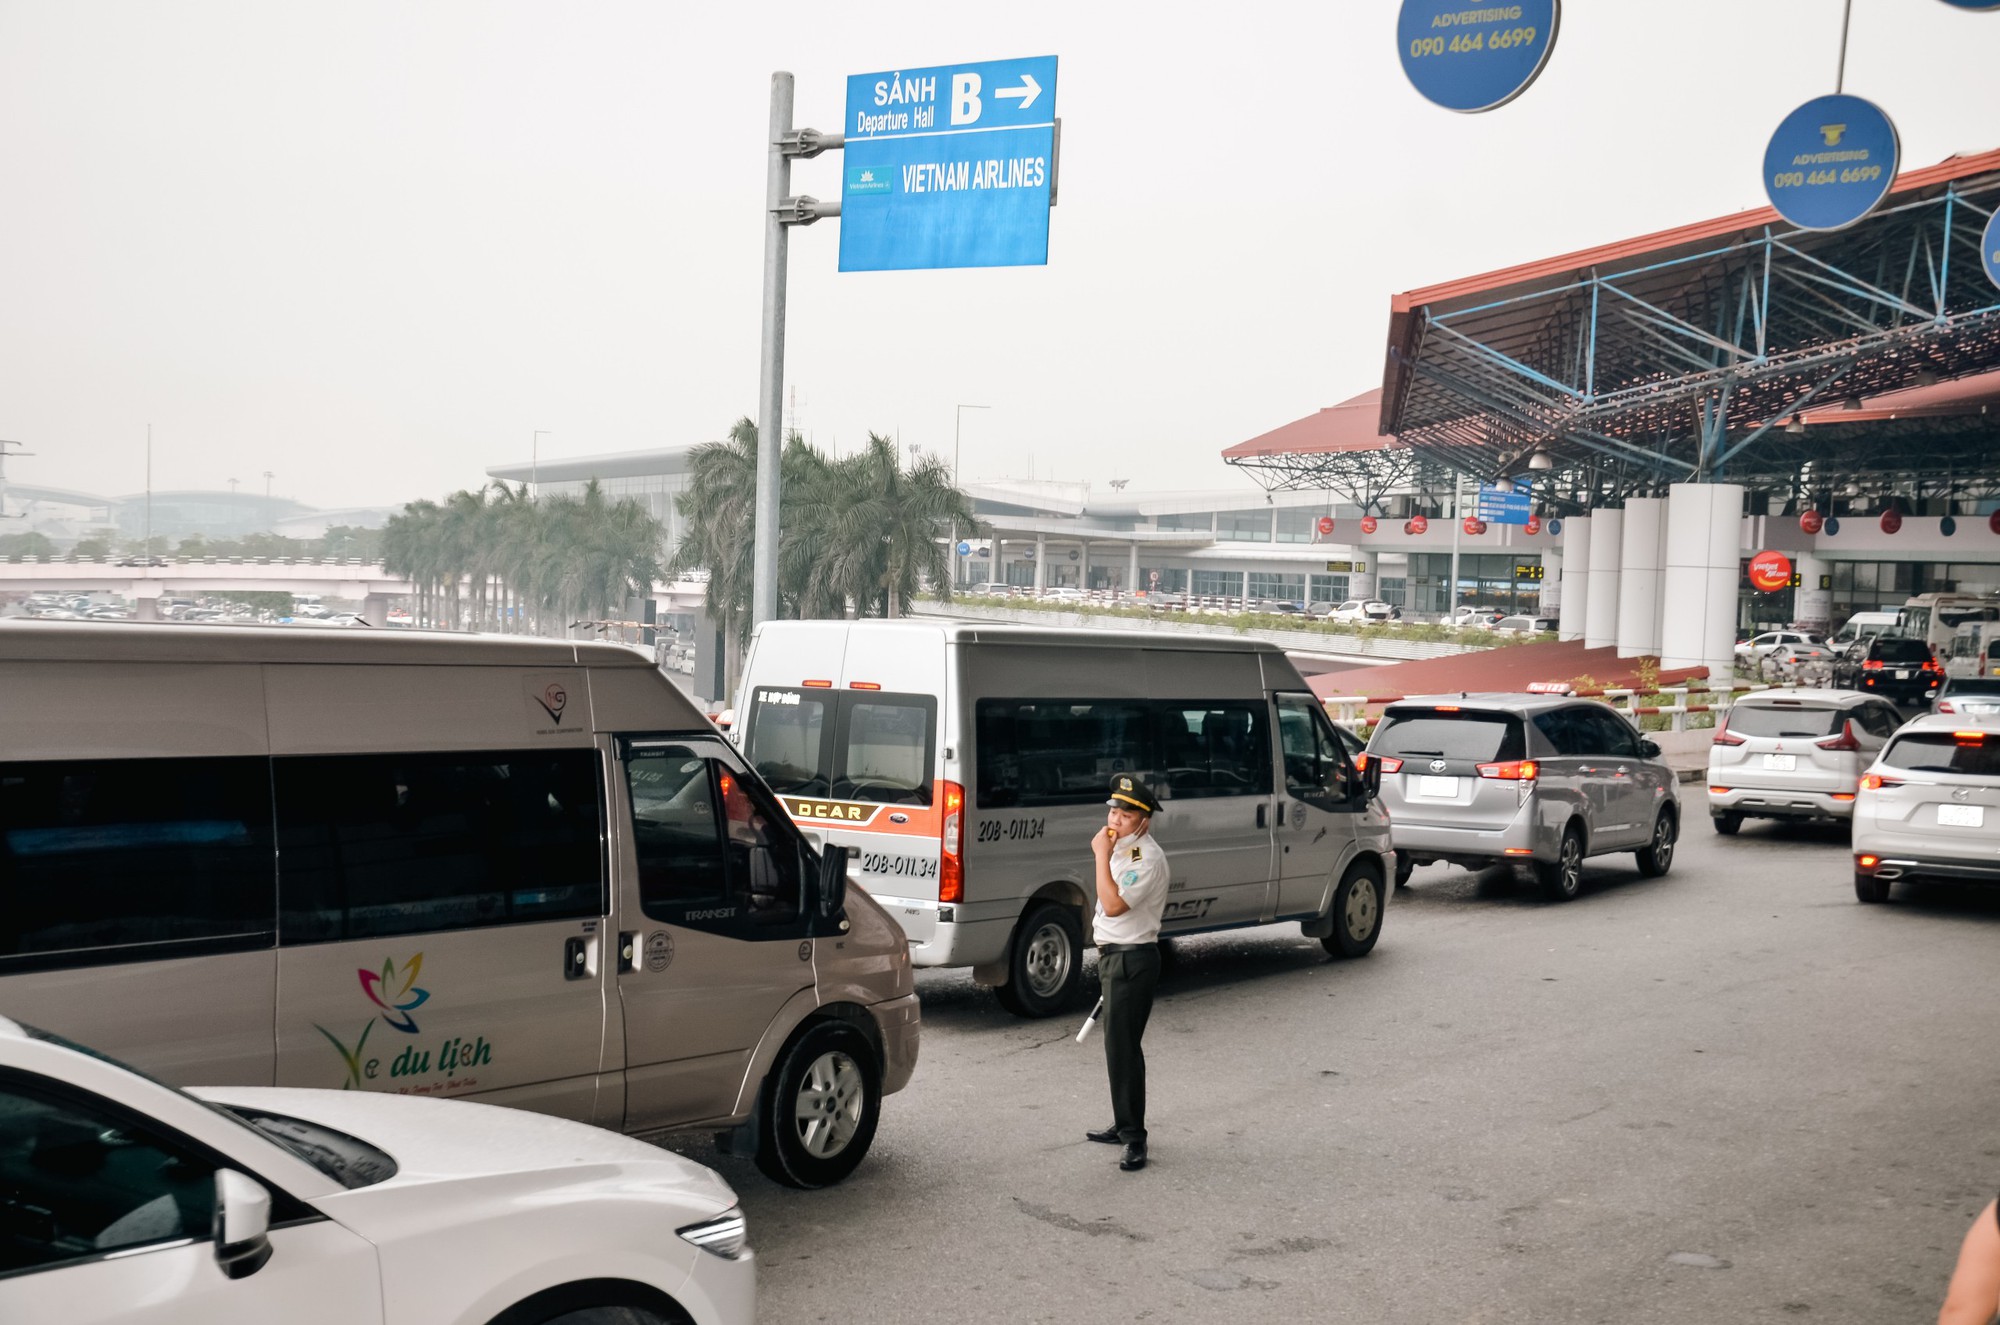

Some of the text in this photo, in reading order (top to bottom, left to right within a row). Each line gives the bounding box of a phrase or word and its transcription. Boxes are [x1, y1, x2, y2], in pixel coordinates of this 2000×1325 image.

[1432, 6, 1522, 28] ADVERTISING
[1411, 27, 1536, 57] 090 464 6699
[874, 71, 982, 126] SẢNH B
[857, 105, 934, 137] Departure Hall
[1792, 149, 1869, 165] ADVERTISING
[902, 157, 1045, 193] VIETNAM AIRLINES
[1774, 165, 1881, 188] 090 464 6699
[799, 803, 861, 820] DCAR
[977, 817, 1045, 842] 20B-011.34
[863, 853, 937, 878] 20B-011.34
[685, 907, 737, 920] TRANSIT
[390, 1045, 431, 1077] du
